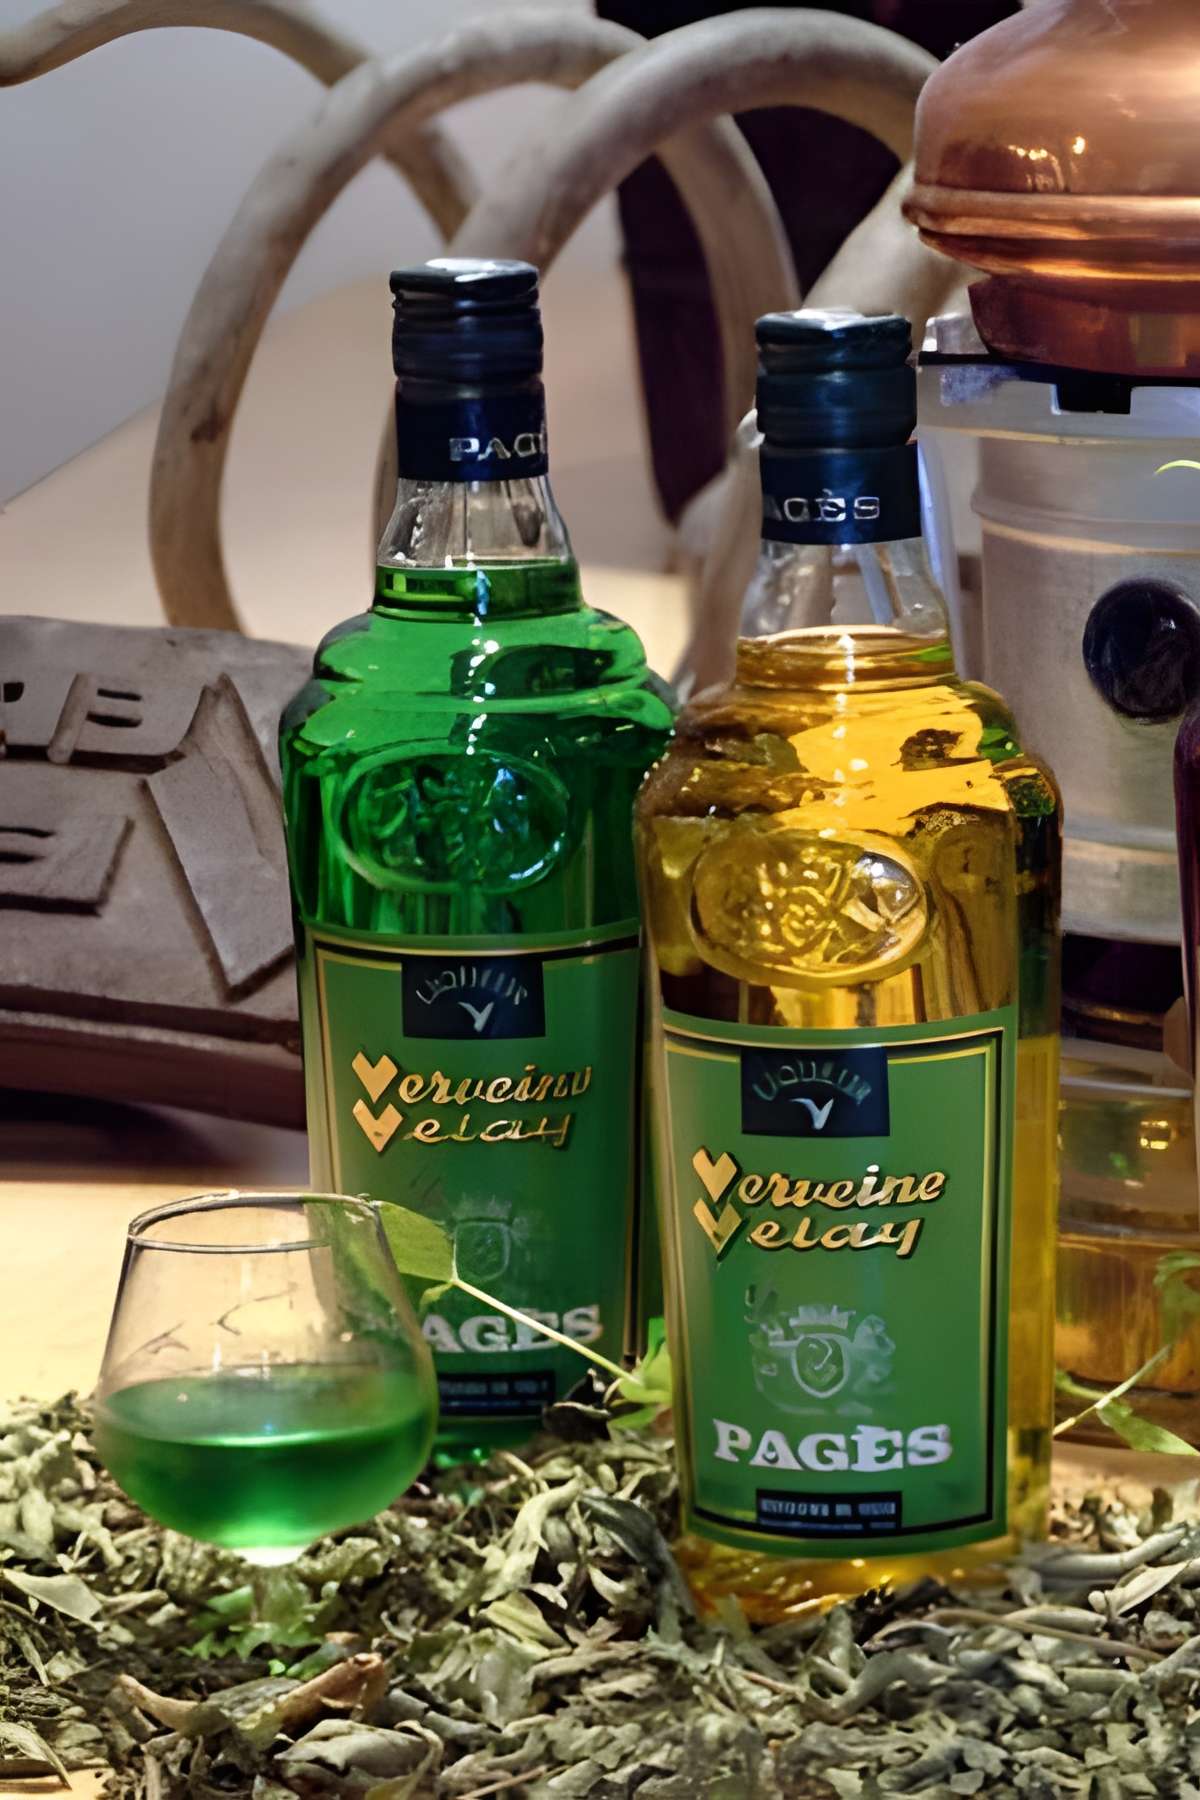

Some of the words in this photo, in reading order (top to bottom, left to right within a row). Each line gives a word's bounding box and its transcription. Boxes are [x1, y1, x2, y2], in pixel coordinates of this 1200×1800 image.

[352, 1098, 574, 1153] Velay
[692, 1147, 946, 1208] Verveine
[693, 1197, 922, 1257] Velay
